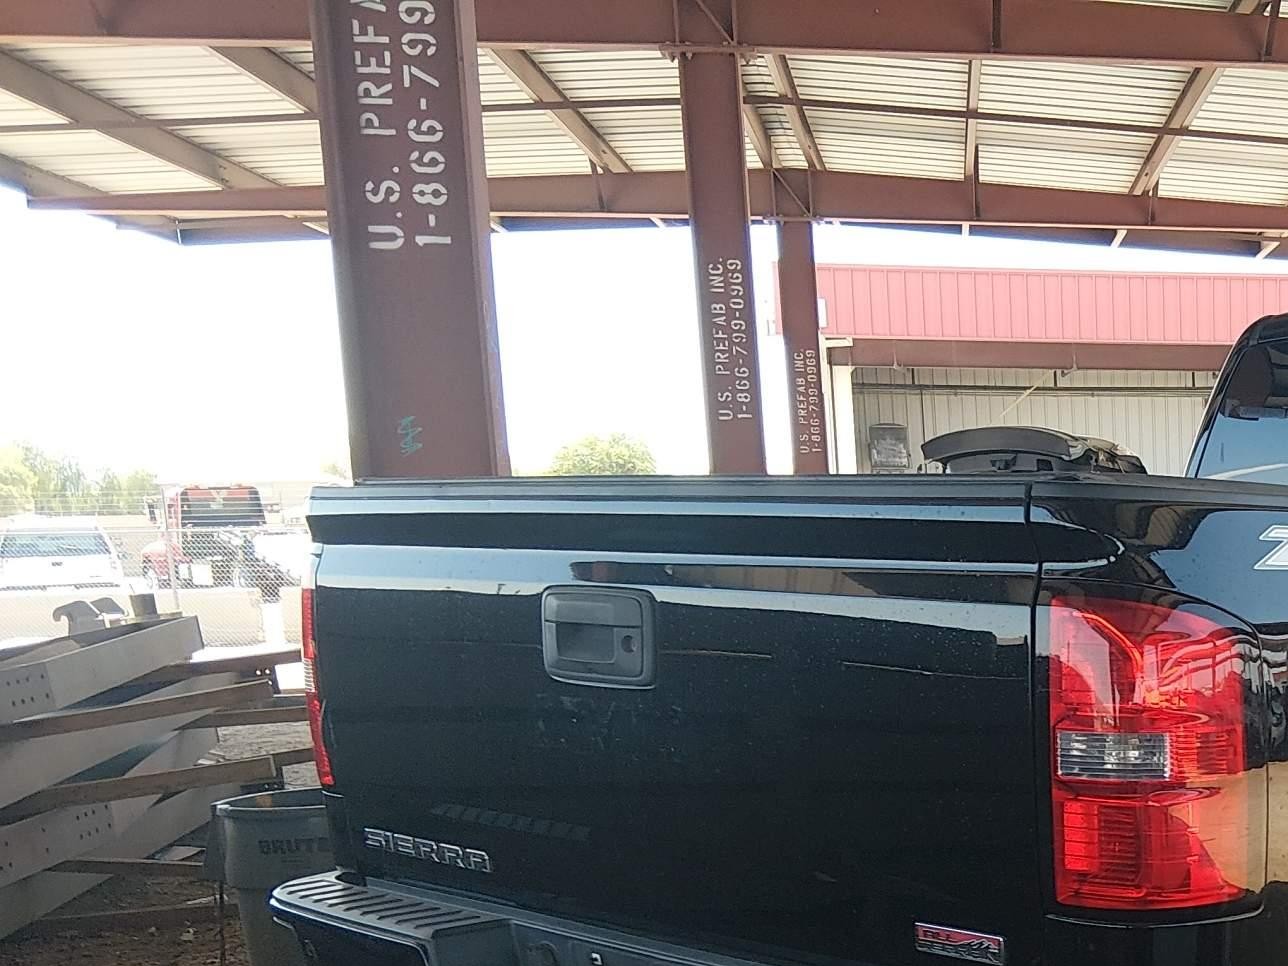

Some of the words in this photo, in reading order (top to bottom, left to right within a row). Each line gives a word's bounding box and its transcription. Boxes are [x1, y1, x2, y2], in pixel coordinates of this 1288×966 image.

[365, 167, 405, 250] U.S.
[708, 257, 726, 293] INC.
[711, 302, 731, 375] PREFAB
[726, 259, 753, 419] 1-866-799-0969
[794, 348, 805, 372] INC.
[717, 385, 734, 421] U.S.
[796, 377, 808, 424] PREFAB
[800, 430, 810, 453] U.S.
[363, 826, 494, 873] SIERRA
